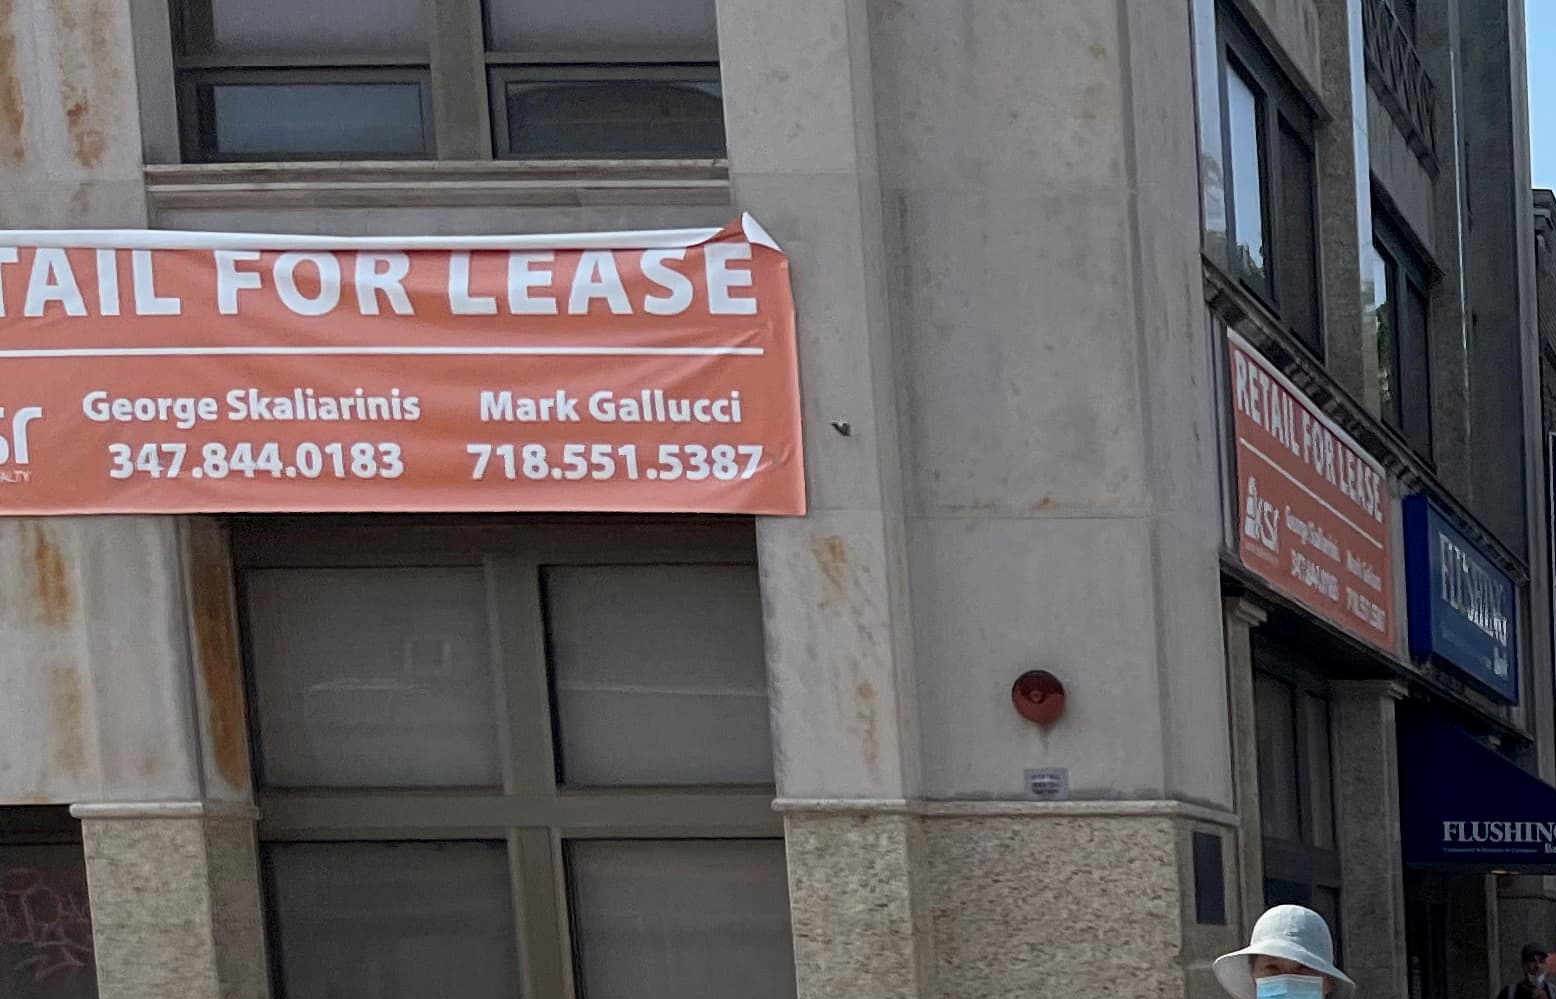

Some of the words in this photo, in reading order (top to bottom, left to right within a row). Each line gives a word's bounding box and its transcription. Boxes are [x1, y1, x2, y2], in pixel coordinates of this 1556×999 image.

[213, 250, 415, 316] FOR
[447, 245, 760, 317] LEASE
[82, 390, 218, 426] George
[227, 387, 421, 422] Skaliarinis
[479, 392, 580, 422] Mark
[588, 390, 742, 423] Gallucci
[1234, 350, 1300, 457] RETAIL
[1302, 411, 1336, 485] FOR
[1338, 440, 1384, 524] LEASE
[108, 442, 404, 480] 347.844.0183
[466, 443, 763, 481] 718.551.5387
